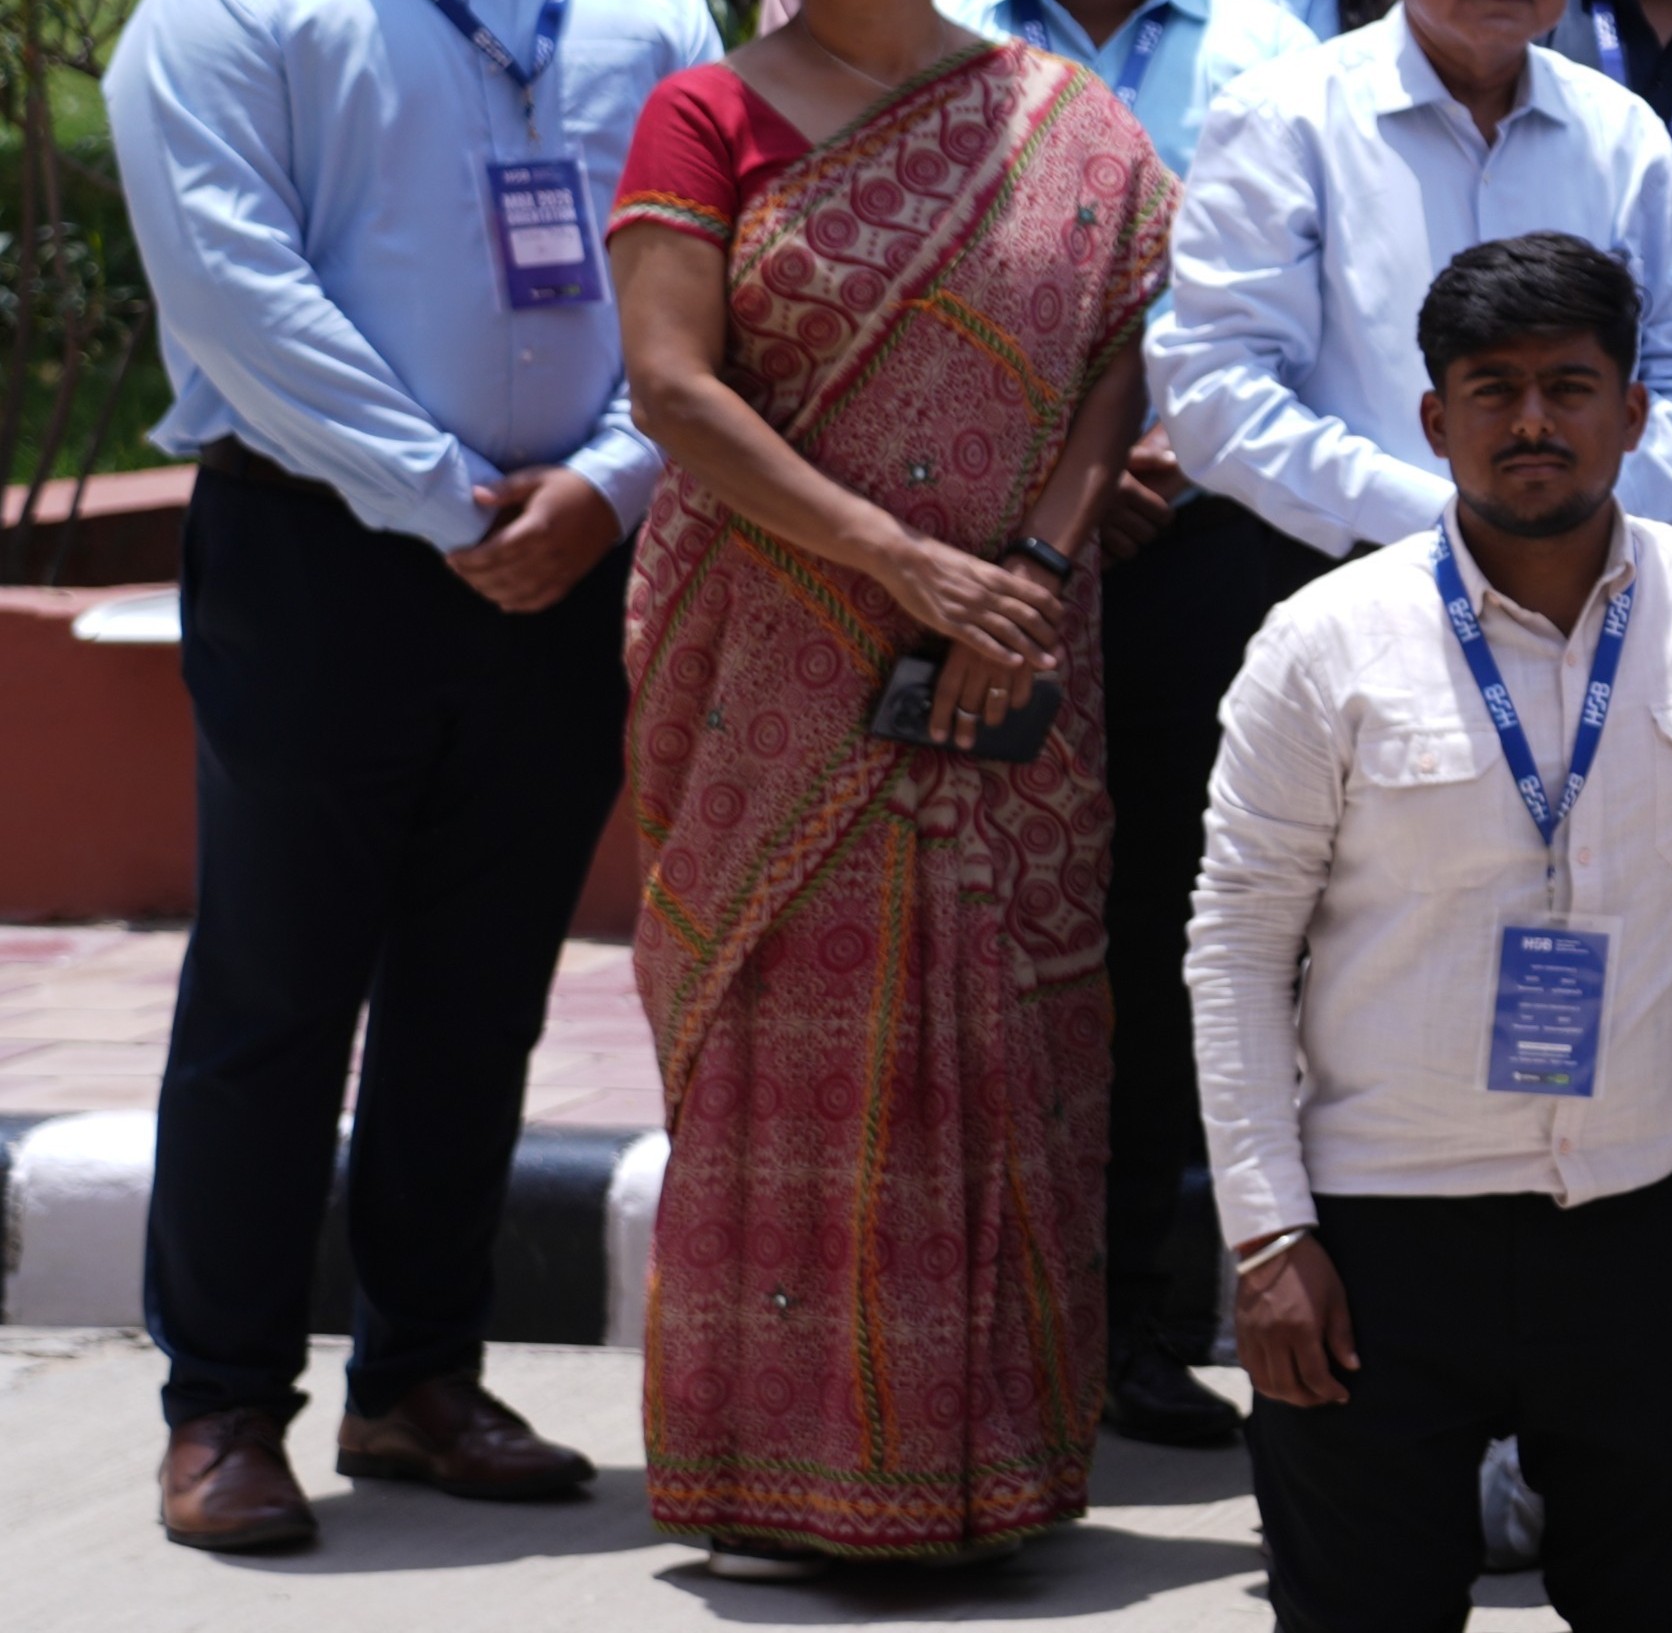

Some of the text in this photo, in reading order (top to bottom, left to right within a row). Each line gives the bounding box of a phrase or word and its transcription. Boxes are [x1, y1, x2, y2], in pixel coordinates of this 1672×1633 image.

[1448, 596, 1481, 644] HSB
[1604, 591, 1632, 638] HSB
[1484, 683, 1519, 730] HSB
[1583, 680, 1611, 727] HSB
[1518, 774, 1551, 823] HSB
